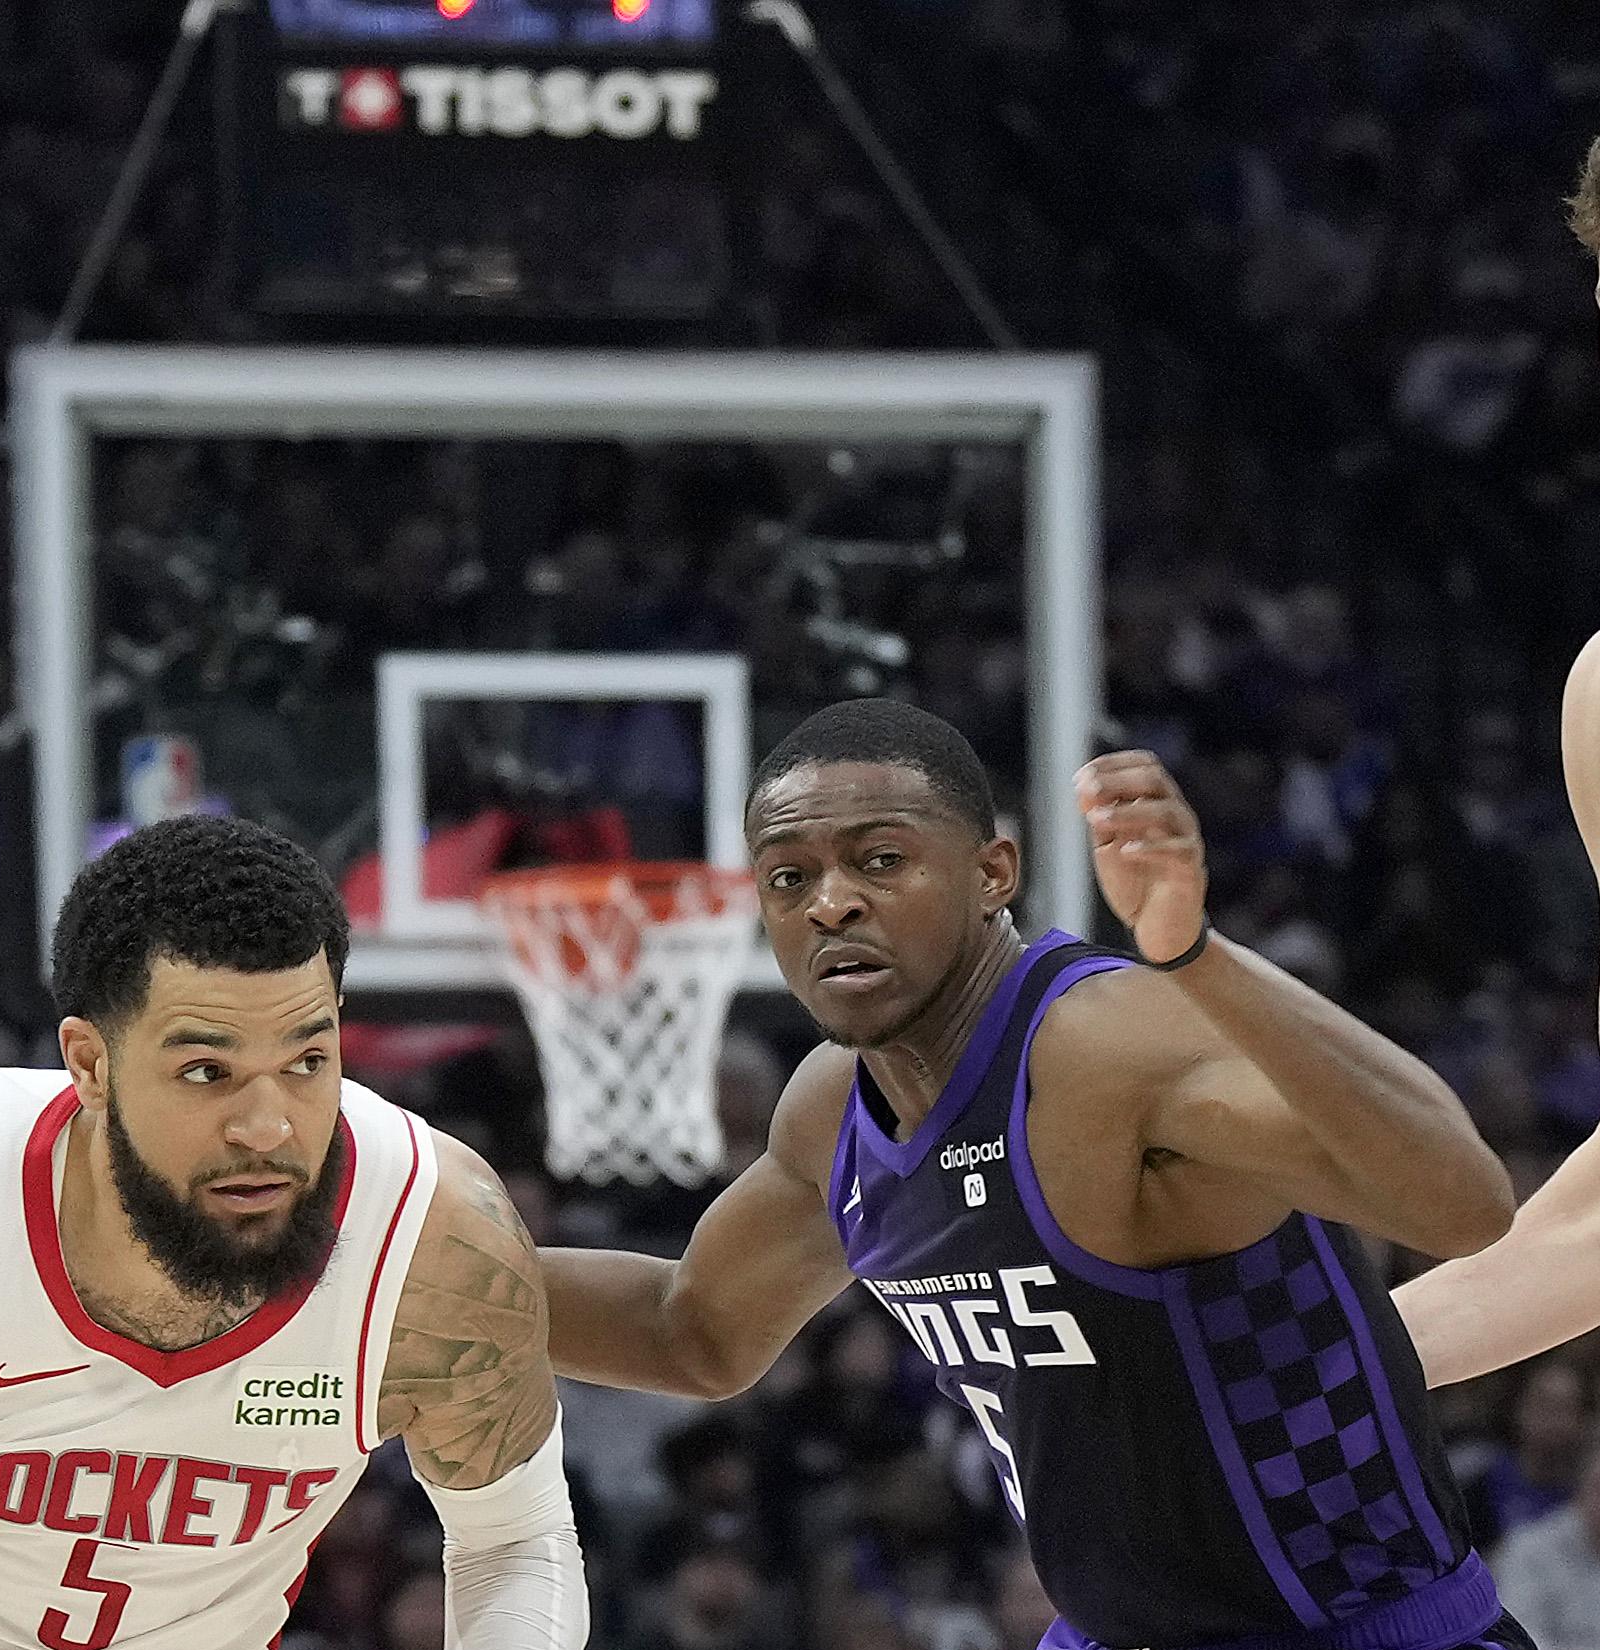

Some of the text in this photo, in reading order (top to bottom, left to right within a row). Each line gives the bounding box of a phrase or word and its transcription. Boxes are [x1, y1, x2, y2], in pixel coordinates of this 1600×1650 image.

[401, 65, 722, 140] TISSOT
[939, 1134, 1005, 1171] dialpad
[873, 1272, 993, 1296] SACRAMENTO
[861, 1265, 1097, 1370] INGS
[244, 1372, 344, 1399] credit
[234, 1400, 341, 1426] karma
